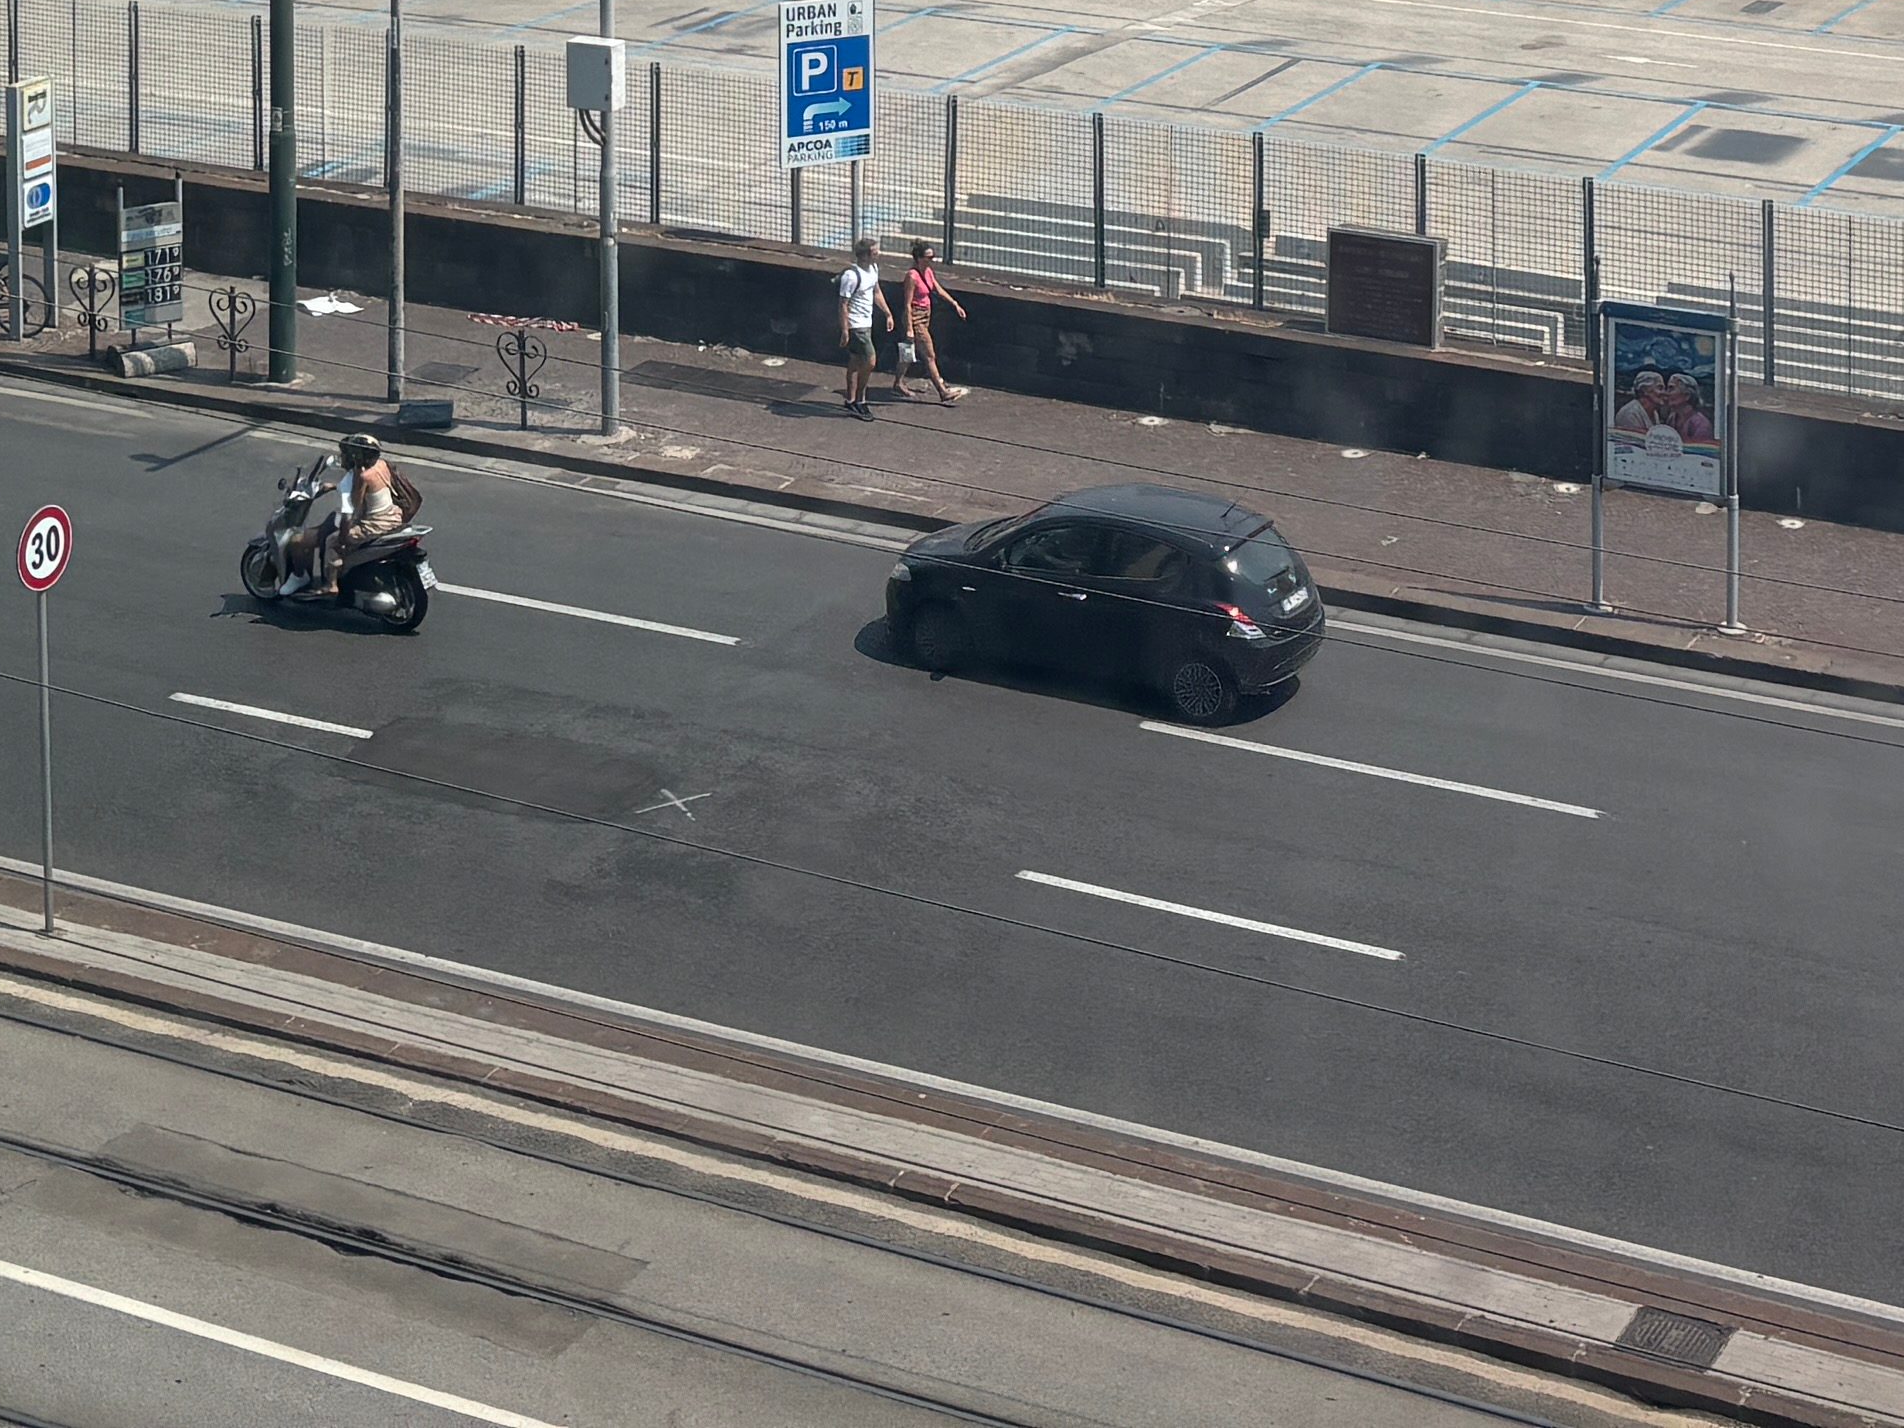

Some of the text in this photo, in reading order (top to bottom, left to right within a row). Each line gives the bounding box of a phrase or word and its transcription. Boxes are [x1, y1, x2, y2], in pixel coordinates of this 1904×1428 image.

[786, 2, 837, 22] URBAN
[786, 20, 842, 39] Parking
[801, 52, 828, 91] P
[847, 71, 859, 87] T
[819, 120, 848, 132] 150 m
[788, 139, 833, 154] APCOA
[787, 149, 833, 164] PARKING
[32, 525, 60, 570] 30
